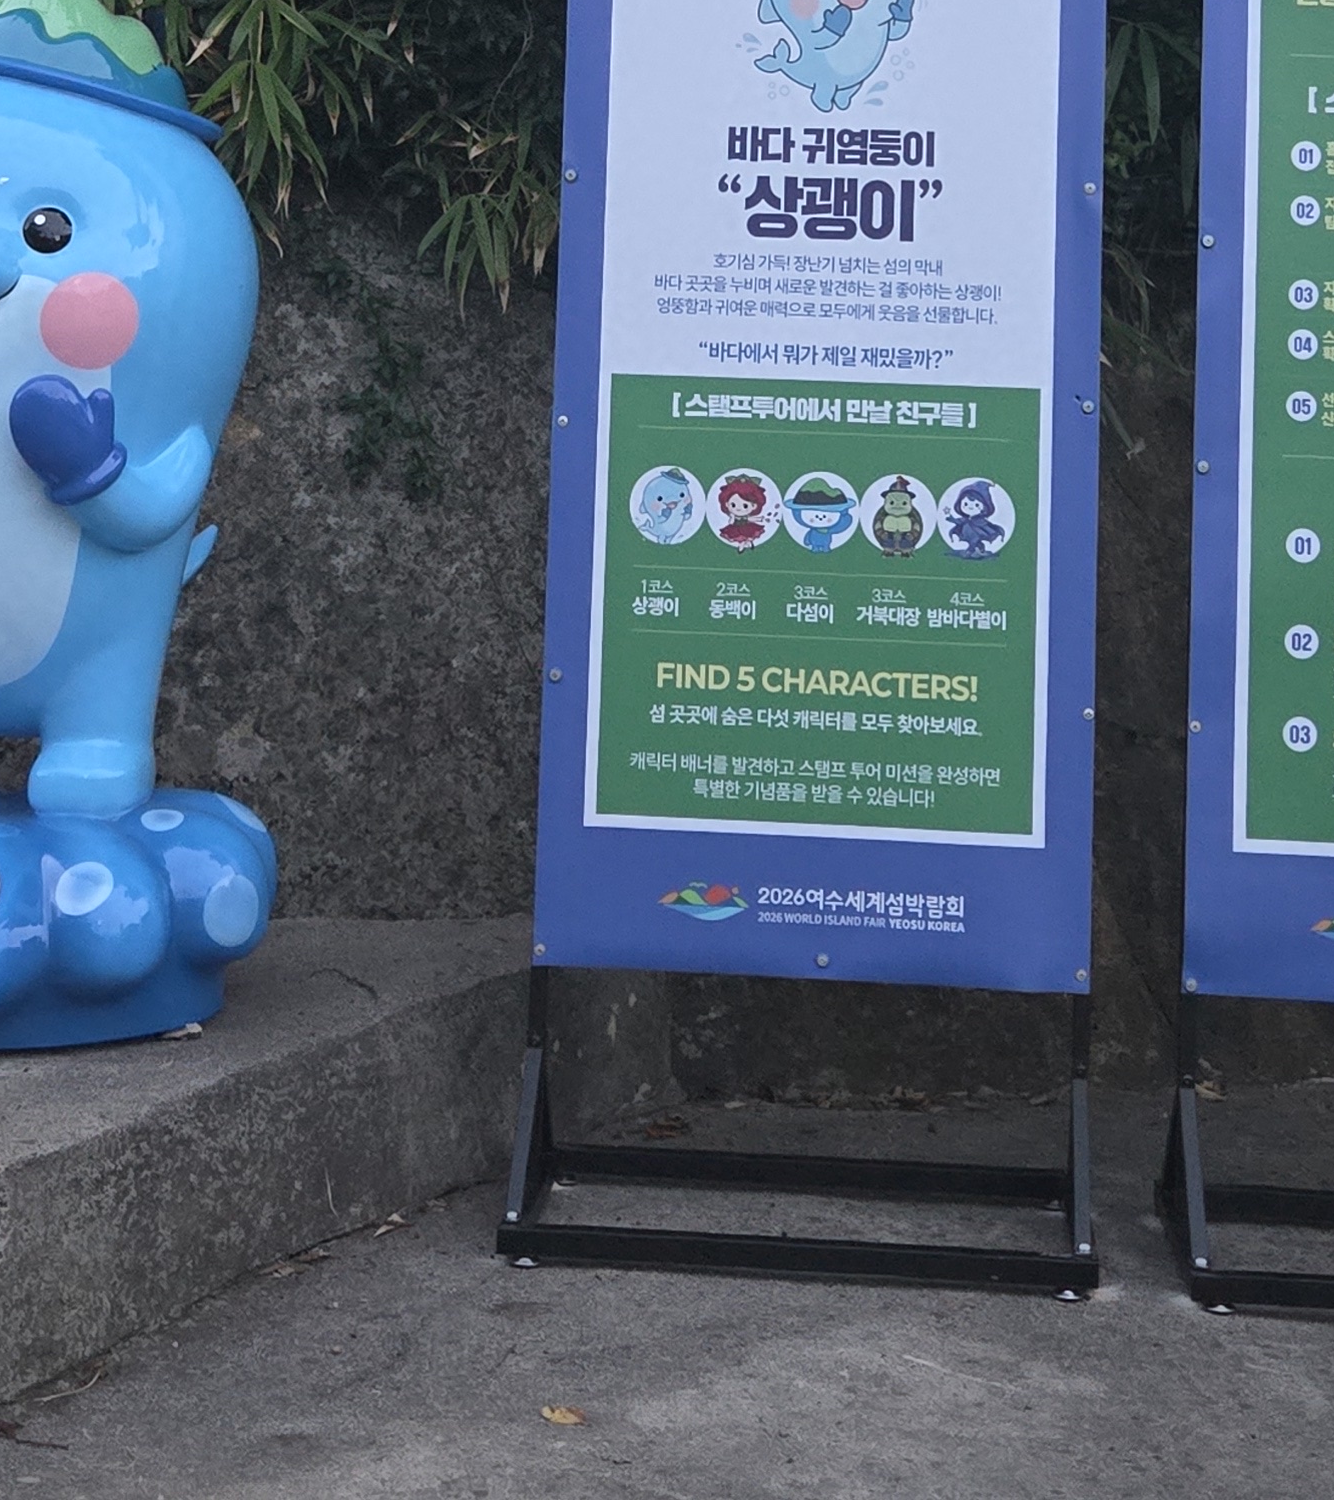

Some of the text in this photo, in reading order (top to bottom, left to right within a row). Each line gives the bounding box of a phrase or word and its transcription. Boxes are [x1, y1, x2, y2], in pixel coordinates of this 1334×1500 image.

[728, 126, 935, 167] 바다 귀염둥이
[1299, 148, 1313, 164] 01
[718, 174, 943, 241] “상괭이”
[1297, 203, 1314, 218] 02
[714, 254, 942, 275] 호기심 가득! 장난기 넘치는 섬의 막내
[654, 275, 1001, 301] 바다 곳곳을 누비며 새로운 발견하는 걸 좋아하는 상괭이!
[1294, 287, 1313, 303] 03
[658, 298, 998, 325] 엉뚱함과 귀여운 매력으로 모두에게 웃음을 선물합니다.
[783, 345, 817, 365] 뭐가
[823, 347, 856, 366] 제일
[1294, 337, 1312, 353] 04
[685, 394, 965, 428] 스탬프투어에서 만날 친구들
[1292, 398, 1311, 415] 05
[1294, 535, 1312, 556] 01
[640, 579, 985, 607] 1코스 2코스 3코스 3코스 4코스
[632, 597, 1007, 630] 상괭이 동백이 다섬이 거북대장 밤바다별이
[1291, 632, 1312, 652] 02
[657, 662, 978, 702] FIND 5 CHARACTERS!
[649, 704, 983, 737] 섬 곳곳에 숨은 다섯 캐릭터를 모두 찾아보세요.
[1289, 724, 1311, 744] 03
[630, 752, 1000, 787] 캐릭터 배너를 발견하고 스탬프 투어 미션을 완성하면
[693, 778, 935, 809] 특별한 기념품을 받을 수 있습니다!
[758, 888, 965, 918] 2026여수세계섬박람회
[758, 912, 965, 932] 2026 WORLD ISLAND FAIR YEOSU KOREA
